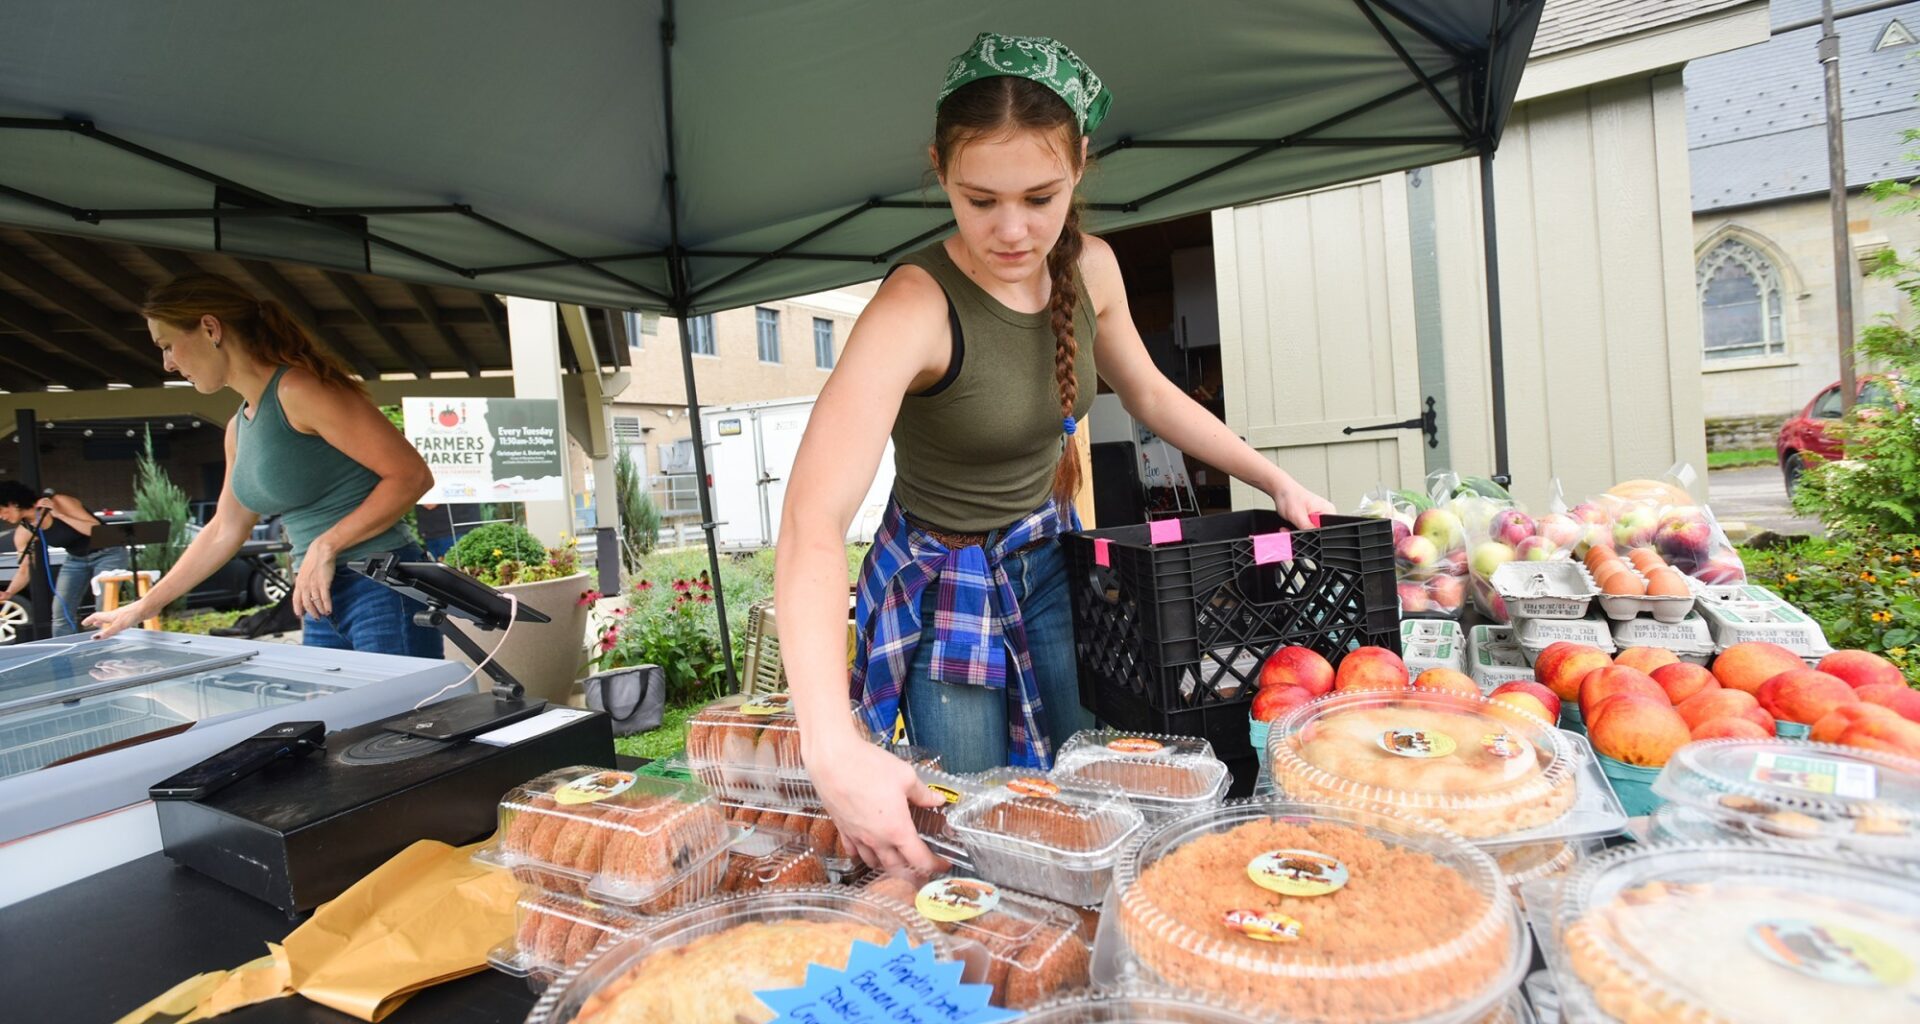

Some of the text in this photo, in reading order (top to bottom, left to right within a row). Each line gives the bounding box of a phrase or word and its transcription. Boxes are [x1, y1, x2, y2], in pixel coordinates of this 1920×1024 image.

[498, 426, 554, 437] Every Tuesday
[415, 436, 484, 451] FARMERS
[1226, 912, 1300, 937] APPLE
